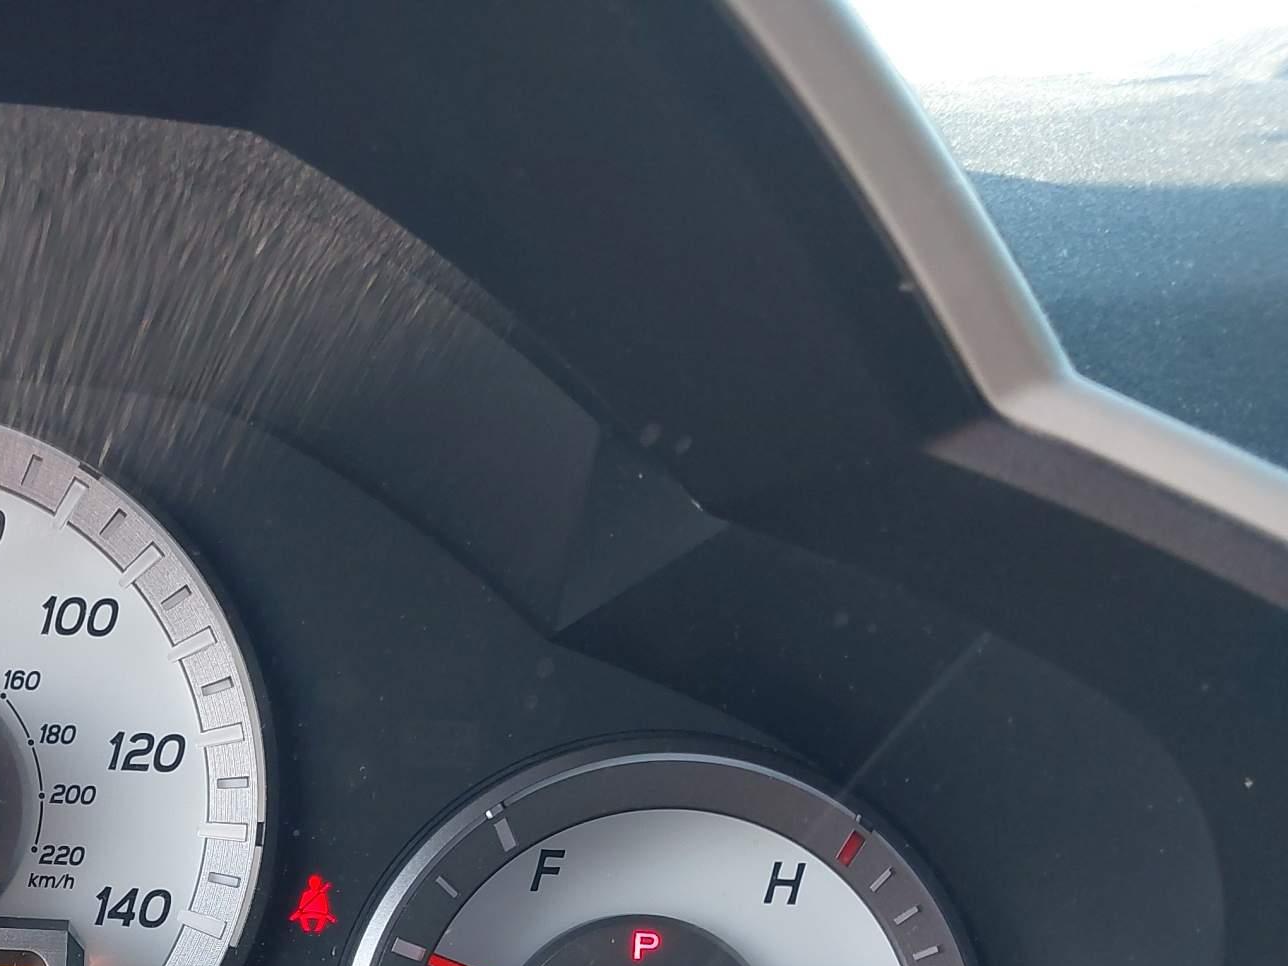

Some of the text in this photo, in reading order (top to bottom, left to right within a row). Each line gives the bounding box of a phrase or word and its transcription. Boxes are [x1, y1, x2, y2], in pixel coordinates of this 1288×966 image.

[40, 596, 119, 637] 100
[2, 670, 41, 692] 160
[39, 724, 76, 746] 180
[107, 732, 186, 773] 120
[49, 785, 96, 806] 200
[38, 845, 86, 867] 220
[529, 849, 566, 891] F
[27, 871, 75, 891] km/h
[763, 861, 806, 904] H
[94, 887, 171, 928] 140
[632, 930, 661, 961] P
